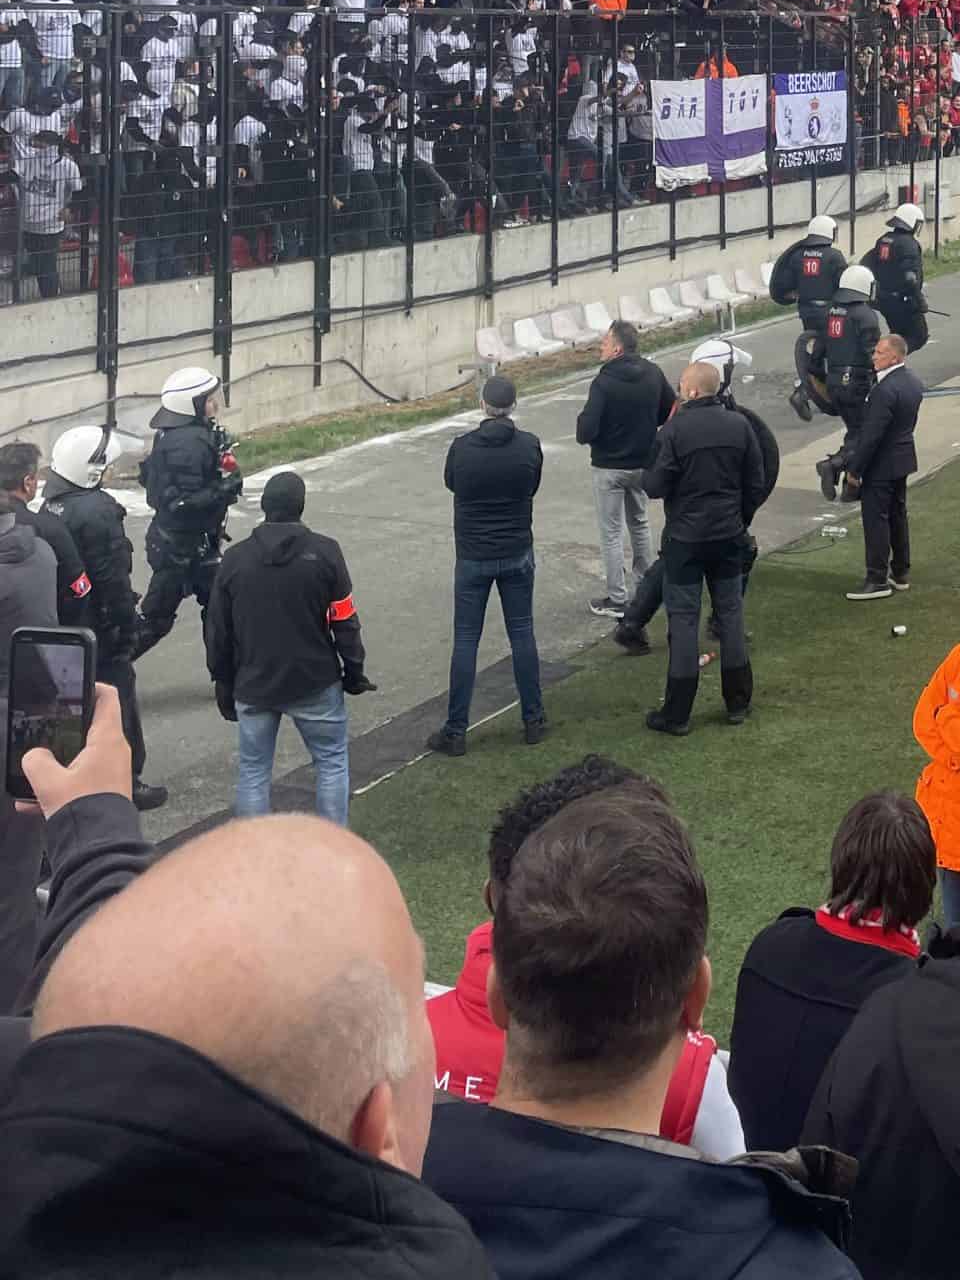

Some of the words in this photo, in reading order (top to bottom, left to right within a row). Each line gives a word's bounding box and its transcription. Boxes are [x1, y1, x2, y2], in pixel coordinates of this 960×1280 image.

[788, 71, 836, 93] BEERSCHOT
[806, 261, 817, 273] 10
[832, 320, 841, 335] 10
